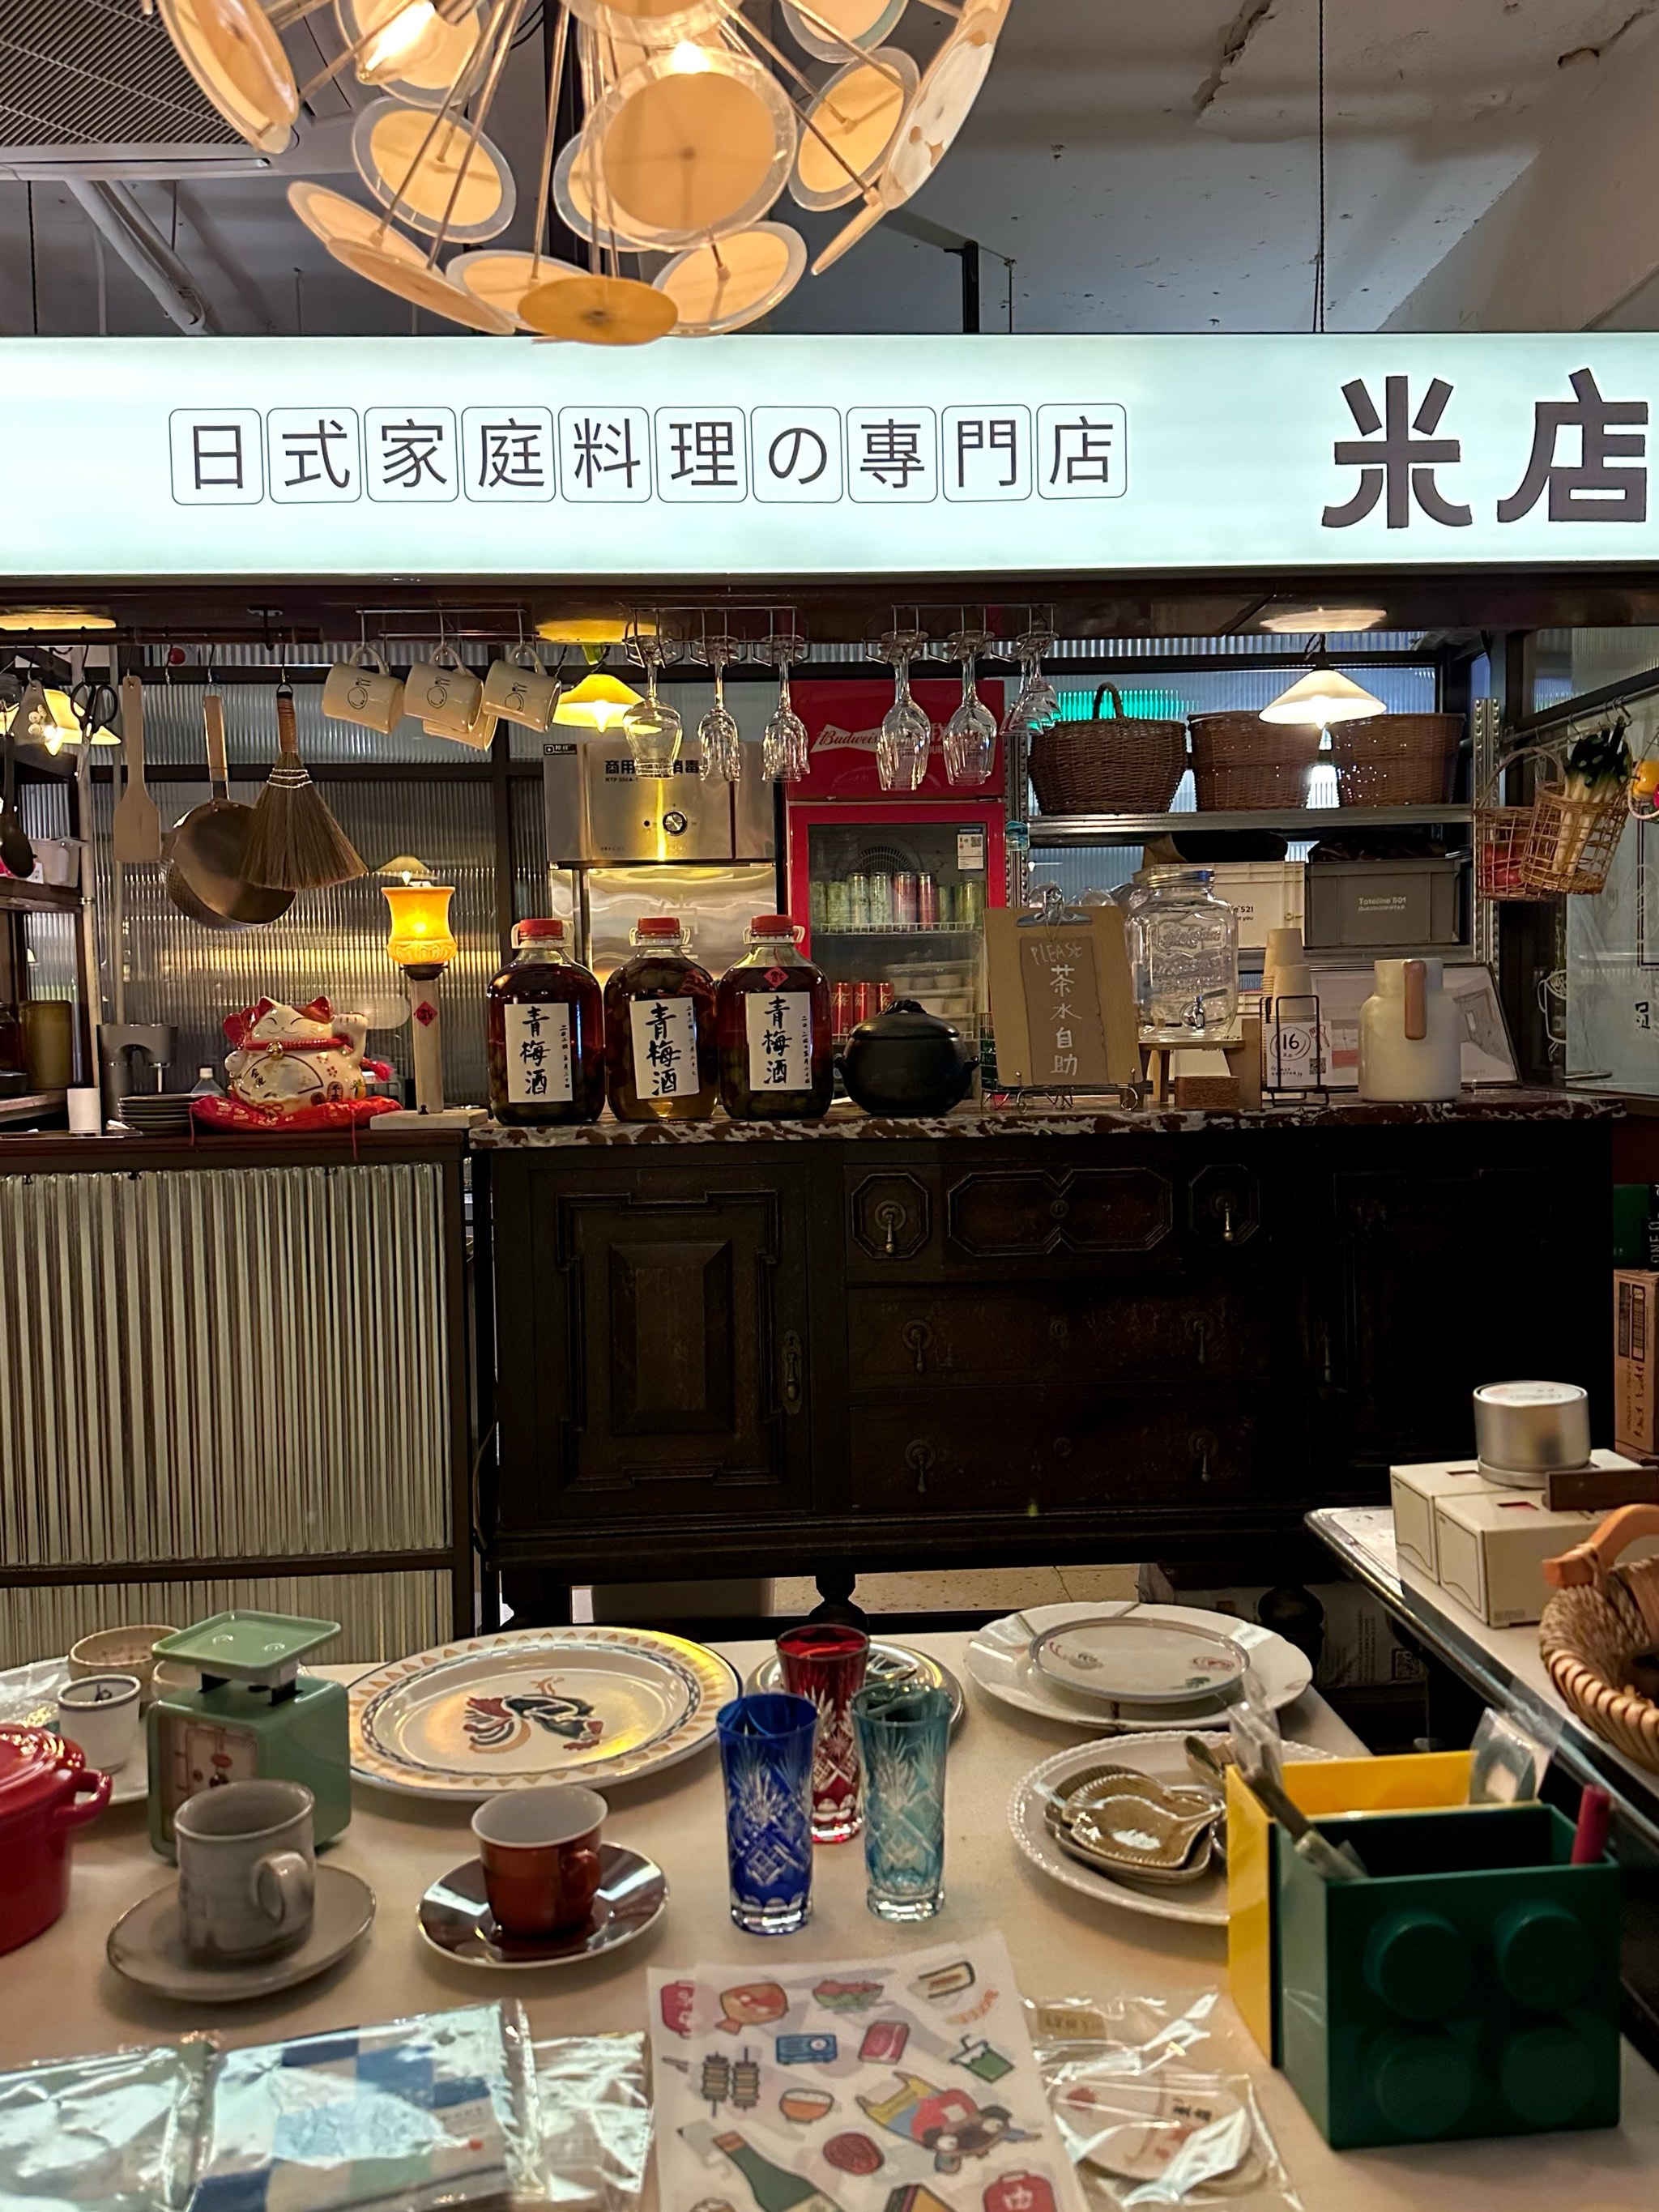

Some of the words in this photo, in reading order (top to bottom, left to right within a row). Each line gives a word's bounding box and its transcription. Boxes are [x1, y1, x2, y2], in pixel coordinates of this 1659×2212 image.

[193, 416, 1113, 491] 日式家庭料理の專門店
[1322, 368, 1648, 529] 米店
[817, 730, 878, 746] Budweis
[519, 1006, 551, 1095] 青梅酒
[645, 1002, 682, 1096] 青梅酒
[761, 995, 793, 1085] 青梅酒
[1050, 964, 1082, 1076] 茶水自助
[1282, 1033, 1299, 1050] 16
